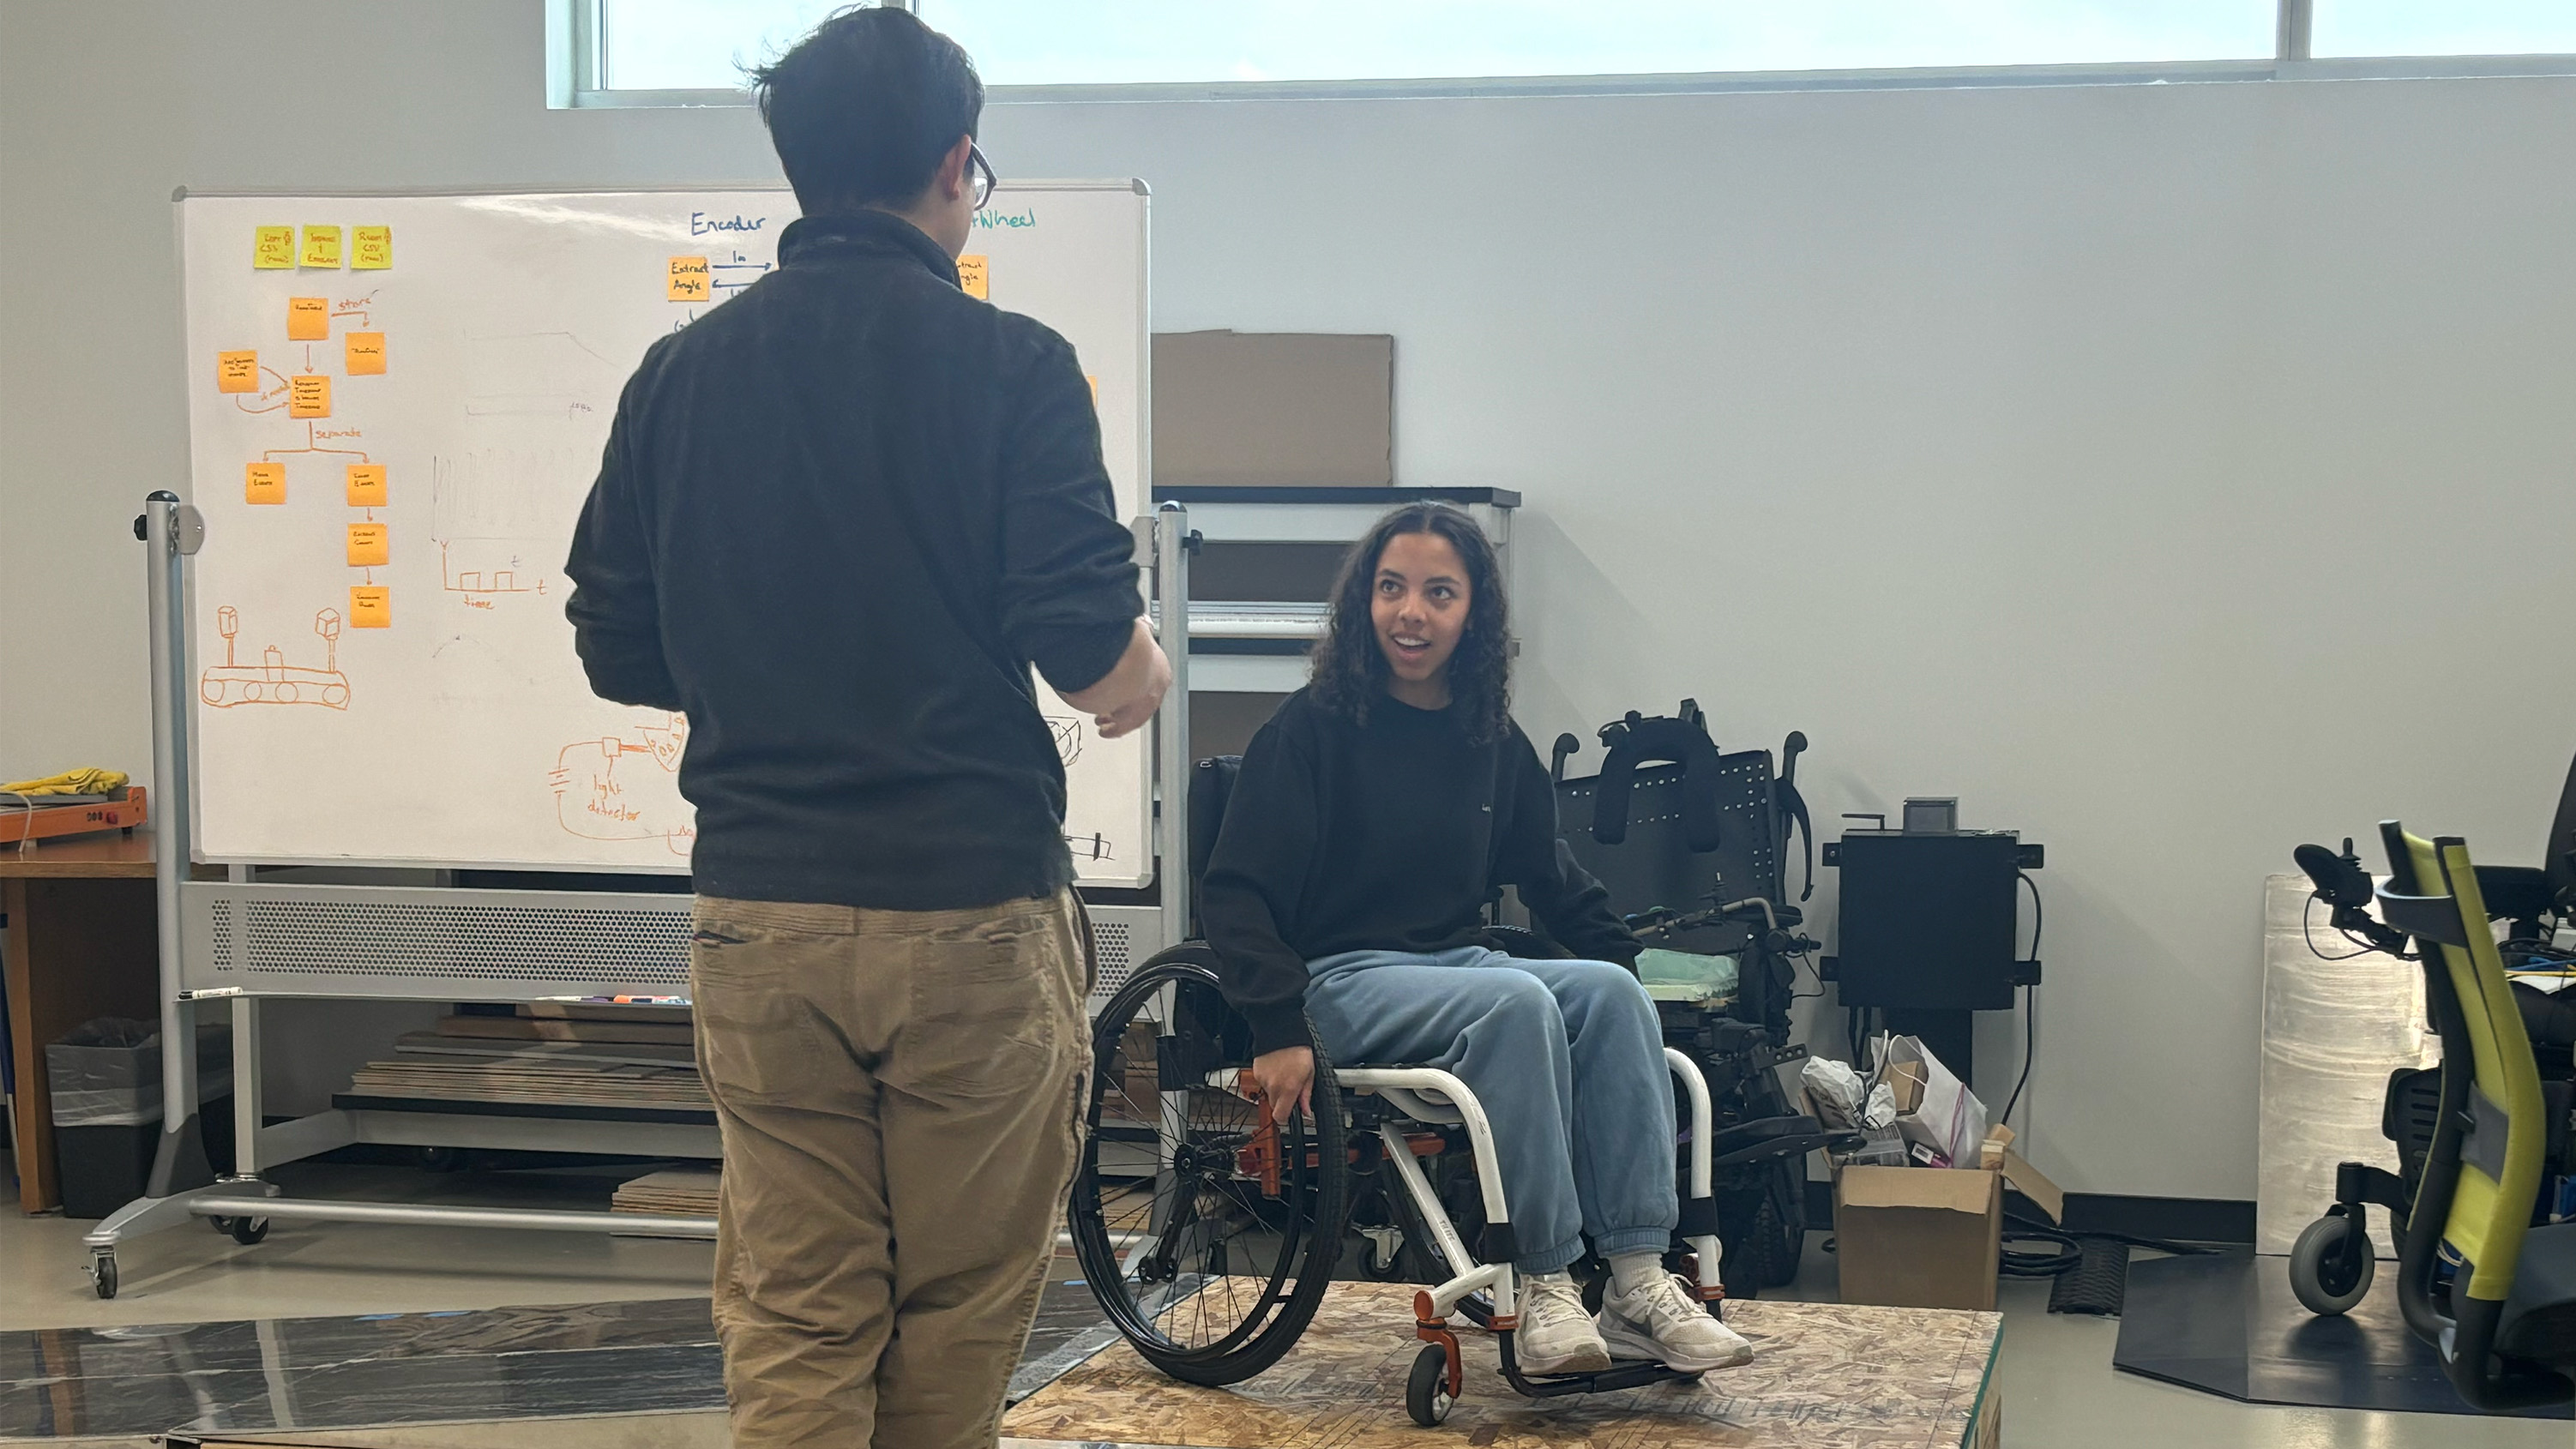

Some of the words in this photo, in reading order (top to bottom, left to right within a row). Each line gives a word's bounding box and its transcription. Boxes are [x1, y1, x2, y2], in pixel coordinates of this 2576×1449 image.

[691, 212, 767, 236] Encoder
[671, 262, 710, 274] Extract
[958, 261, 983, 269] tract
[673, 279, 701, 294] Angle
[960, 273, 979, 286] ngle
[593, 773, 624, 800] light
[587, 798, 641, 821] detector
